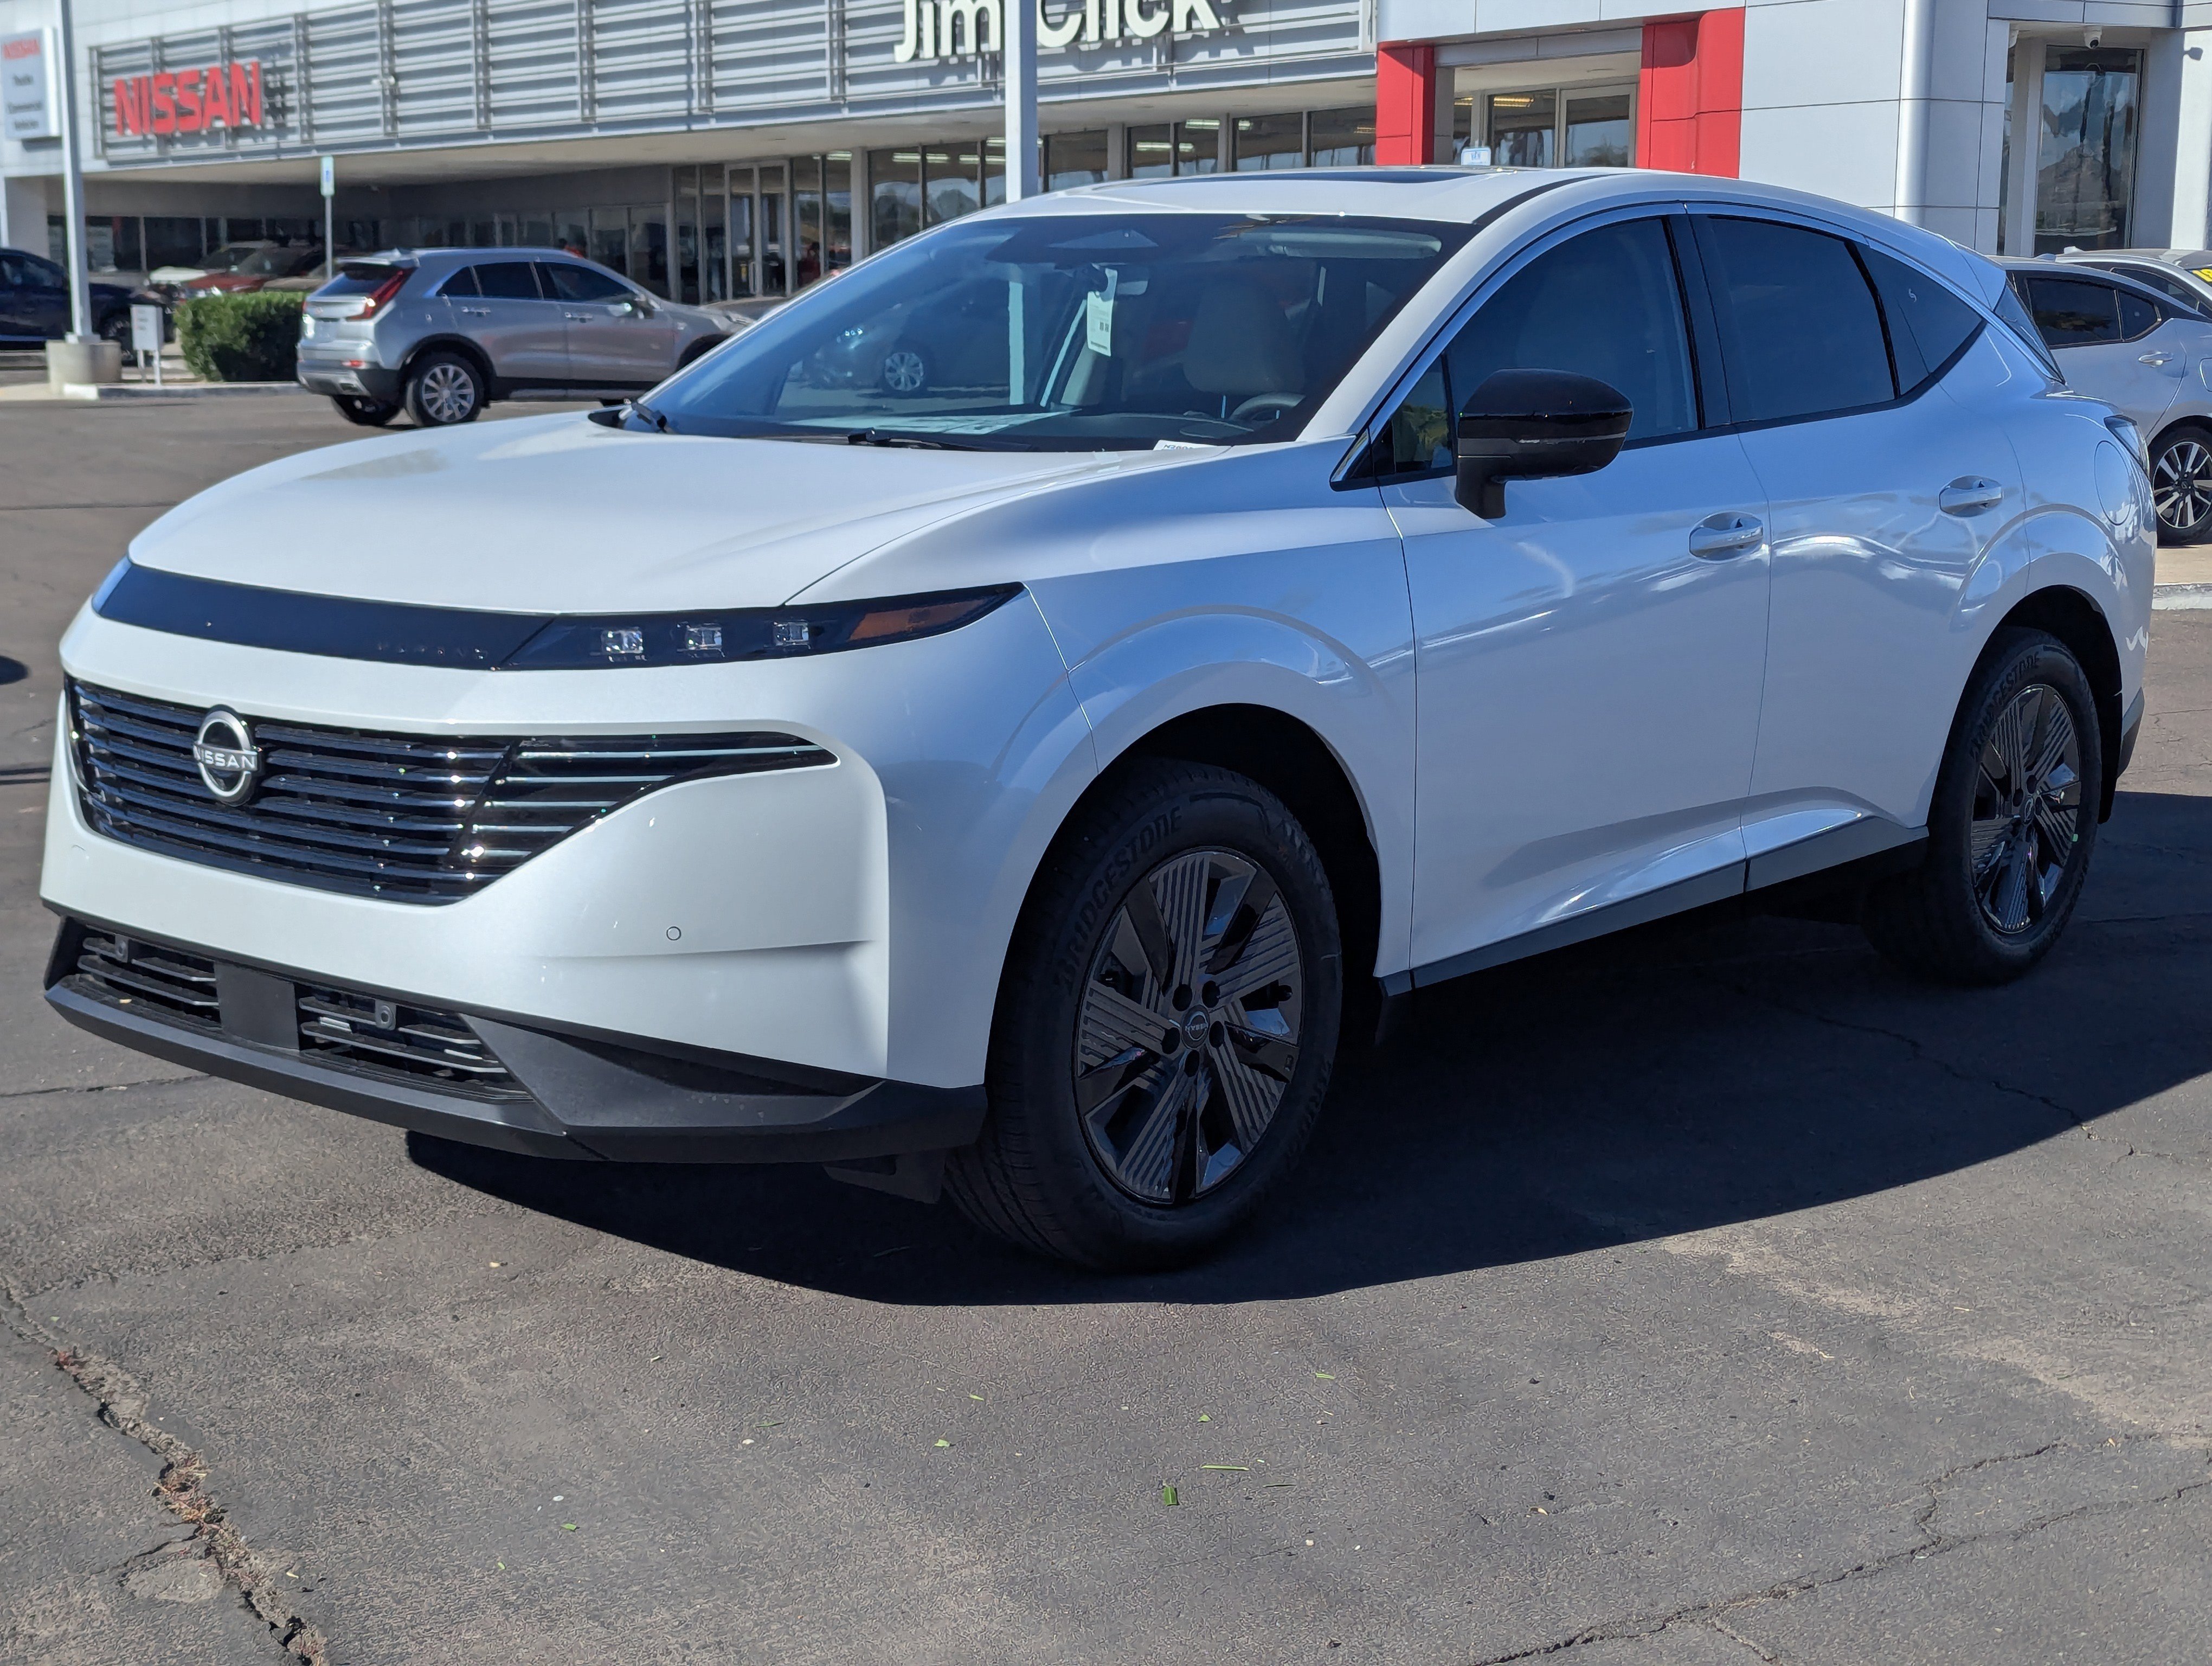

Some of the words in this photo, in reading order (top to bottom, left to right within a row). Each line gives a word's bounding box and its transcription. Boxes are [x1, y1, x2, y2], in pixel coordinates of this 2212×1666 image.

[894, 0, 1001, 63] Jim
[114, 61, 260, 136] NISSAN
[194, 745, 255, 768] NISSAN
